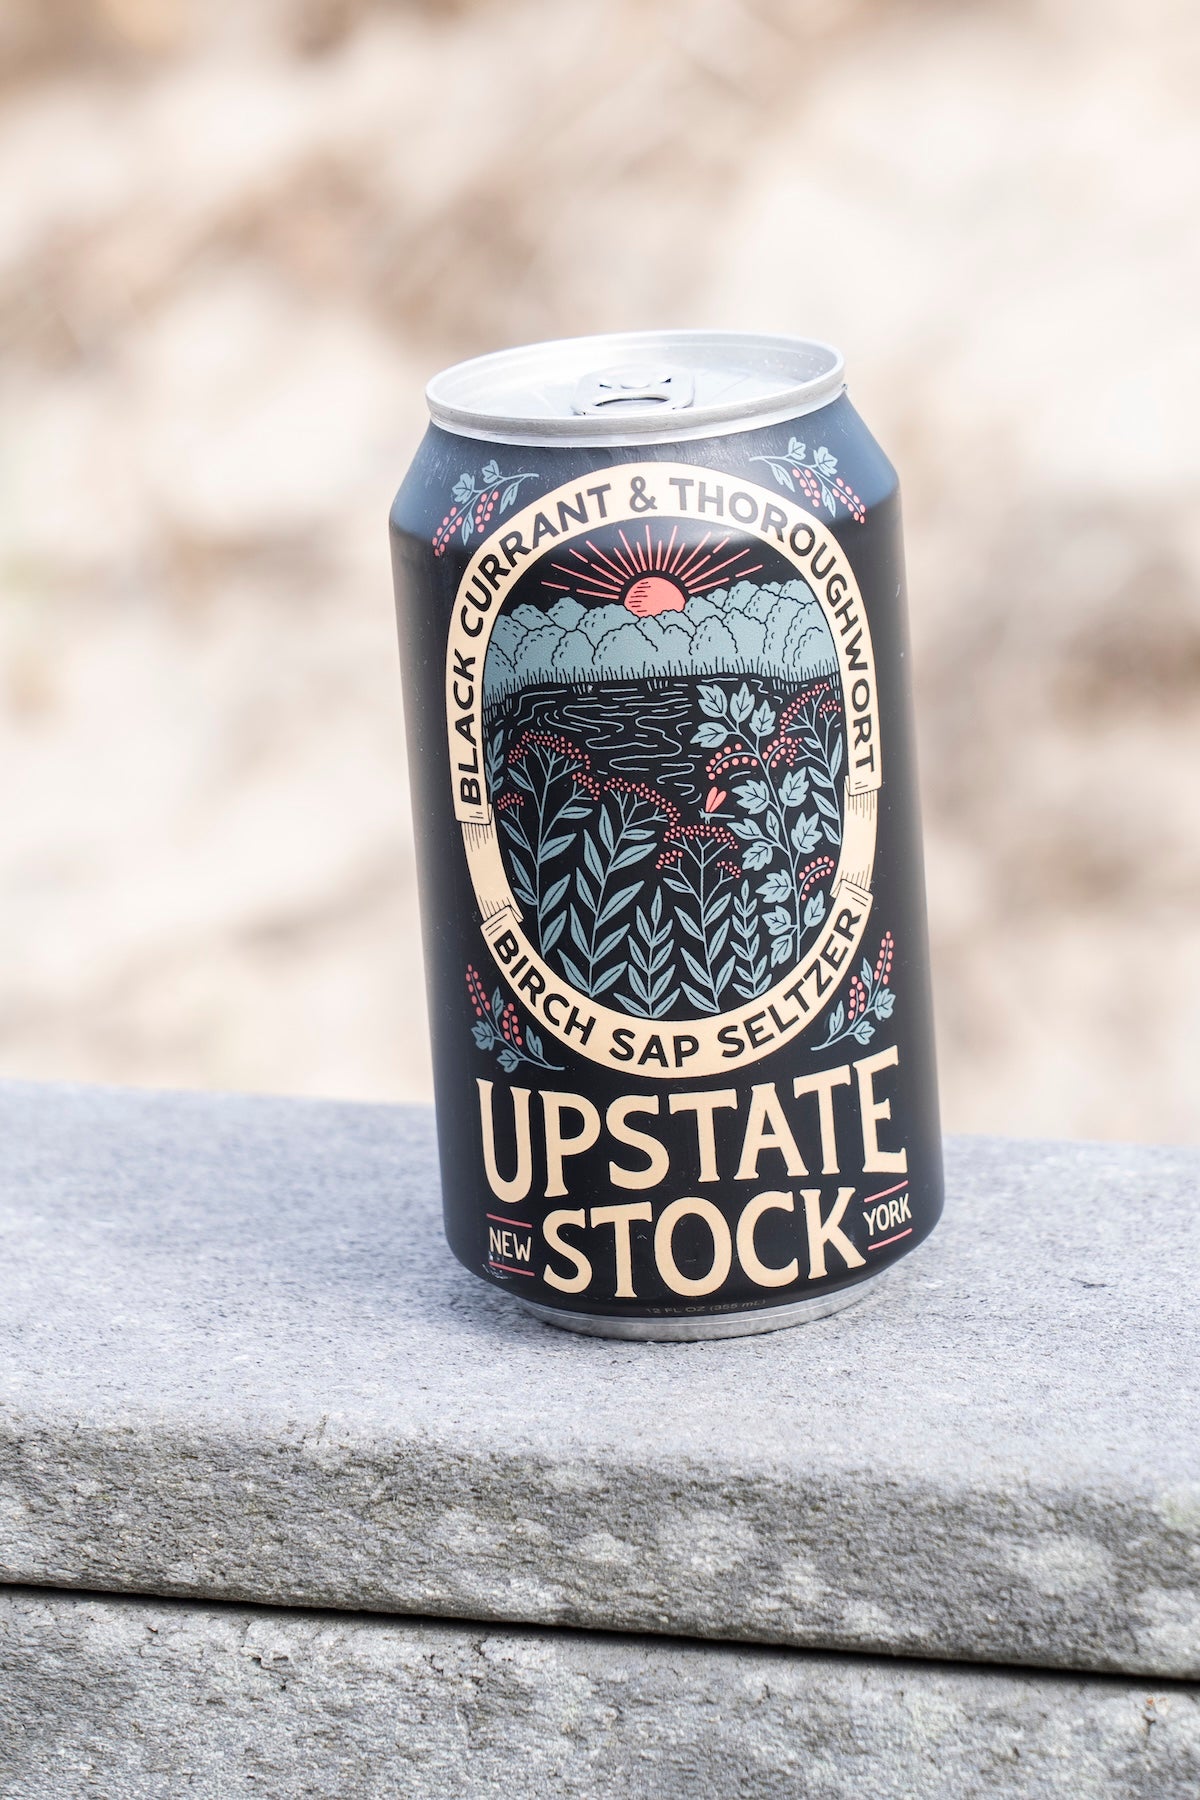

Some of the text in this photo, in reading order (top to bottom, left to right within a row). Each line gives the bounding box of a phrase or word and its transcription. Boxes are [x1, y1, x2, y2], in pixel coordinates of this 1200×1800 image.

[453, 475, 875, 807] BLACK CURRANT & THOROUGHWORT
[493, 907, 863, 1068] BIRCH SAP SELTZER
[476, 1044, 908, 1203] UPSTATE
[489, 1226, 531, 1262] NEW
[542, 1186, 867, 1298] STOCK
[862, 1192, 913, 1237] YORK
[685, 1305, 706, 1313] OZ
